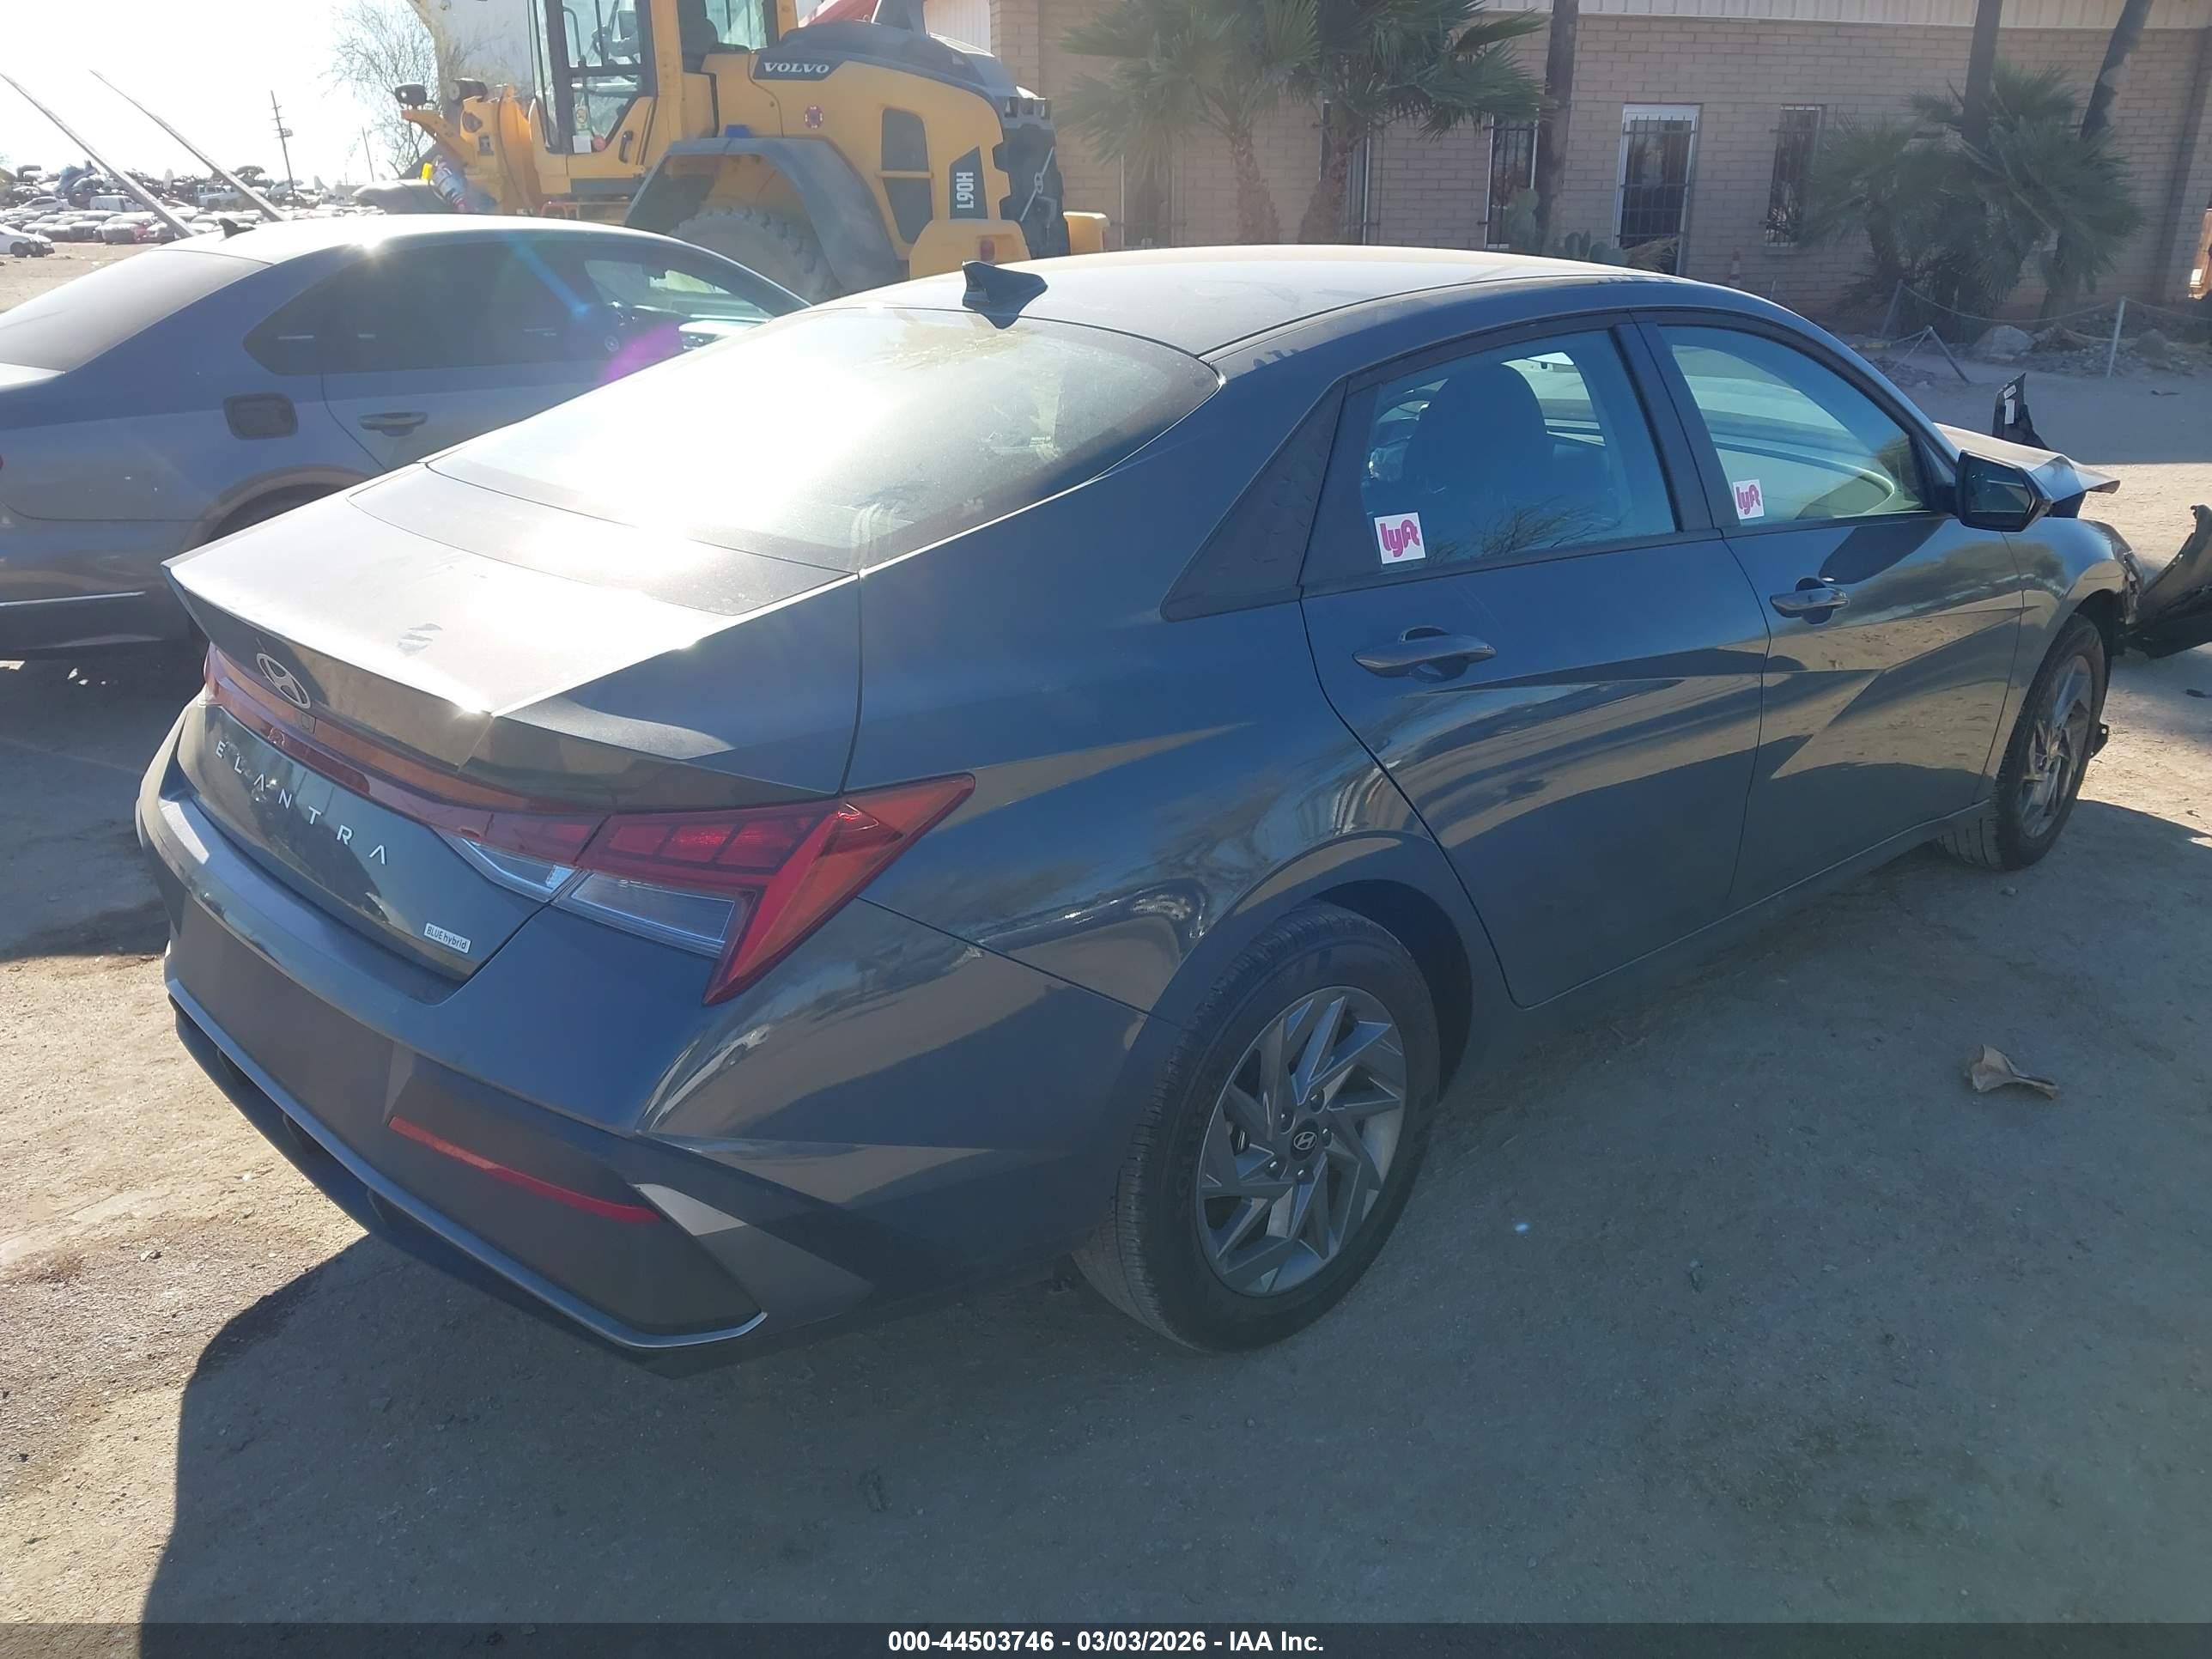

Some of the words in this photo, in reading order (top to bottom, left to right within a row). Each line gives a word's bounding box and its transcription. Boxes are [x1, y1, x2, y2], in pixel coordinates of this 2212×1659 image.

[763, 62, 830, 74] VOLVO
[956, 171, 975, 210] L90H
[1736, 484, 1761, 516] lyft
[1379, 519, 1420, 557] lyft
[215, 740, 387, 866] ELANTRA
[427, 926, 443, 939] BLUE
[443, 933, 467, 950] hybrid
